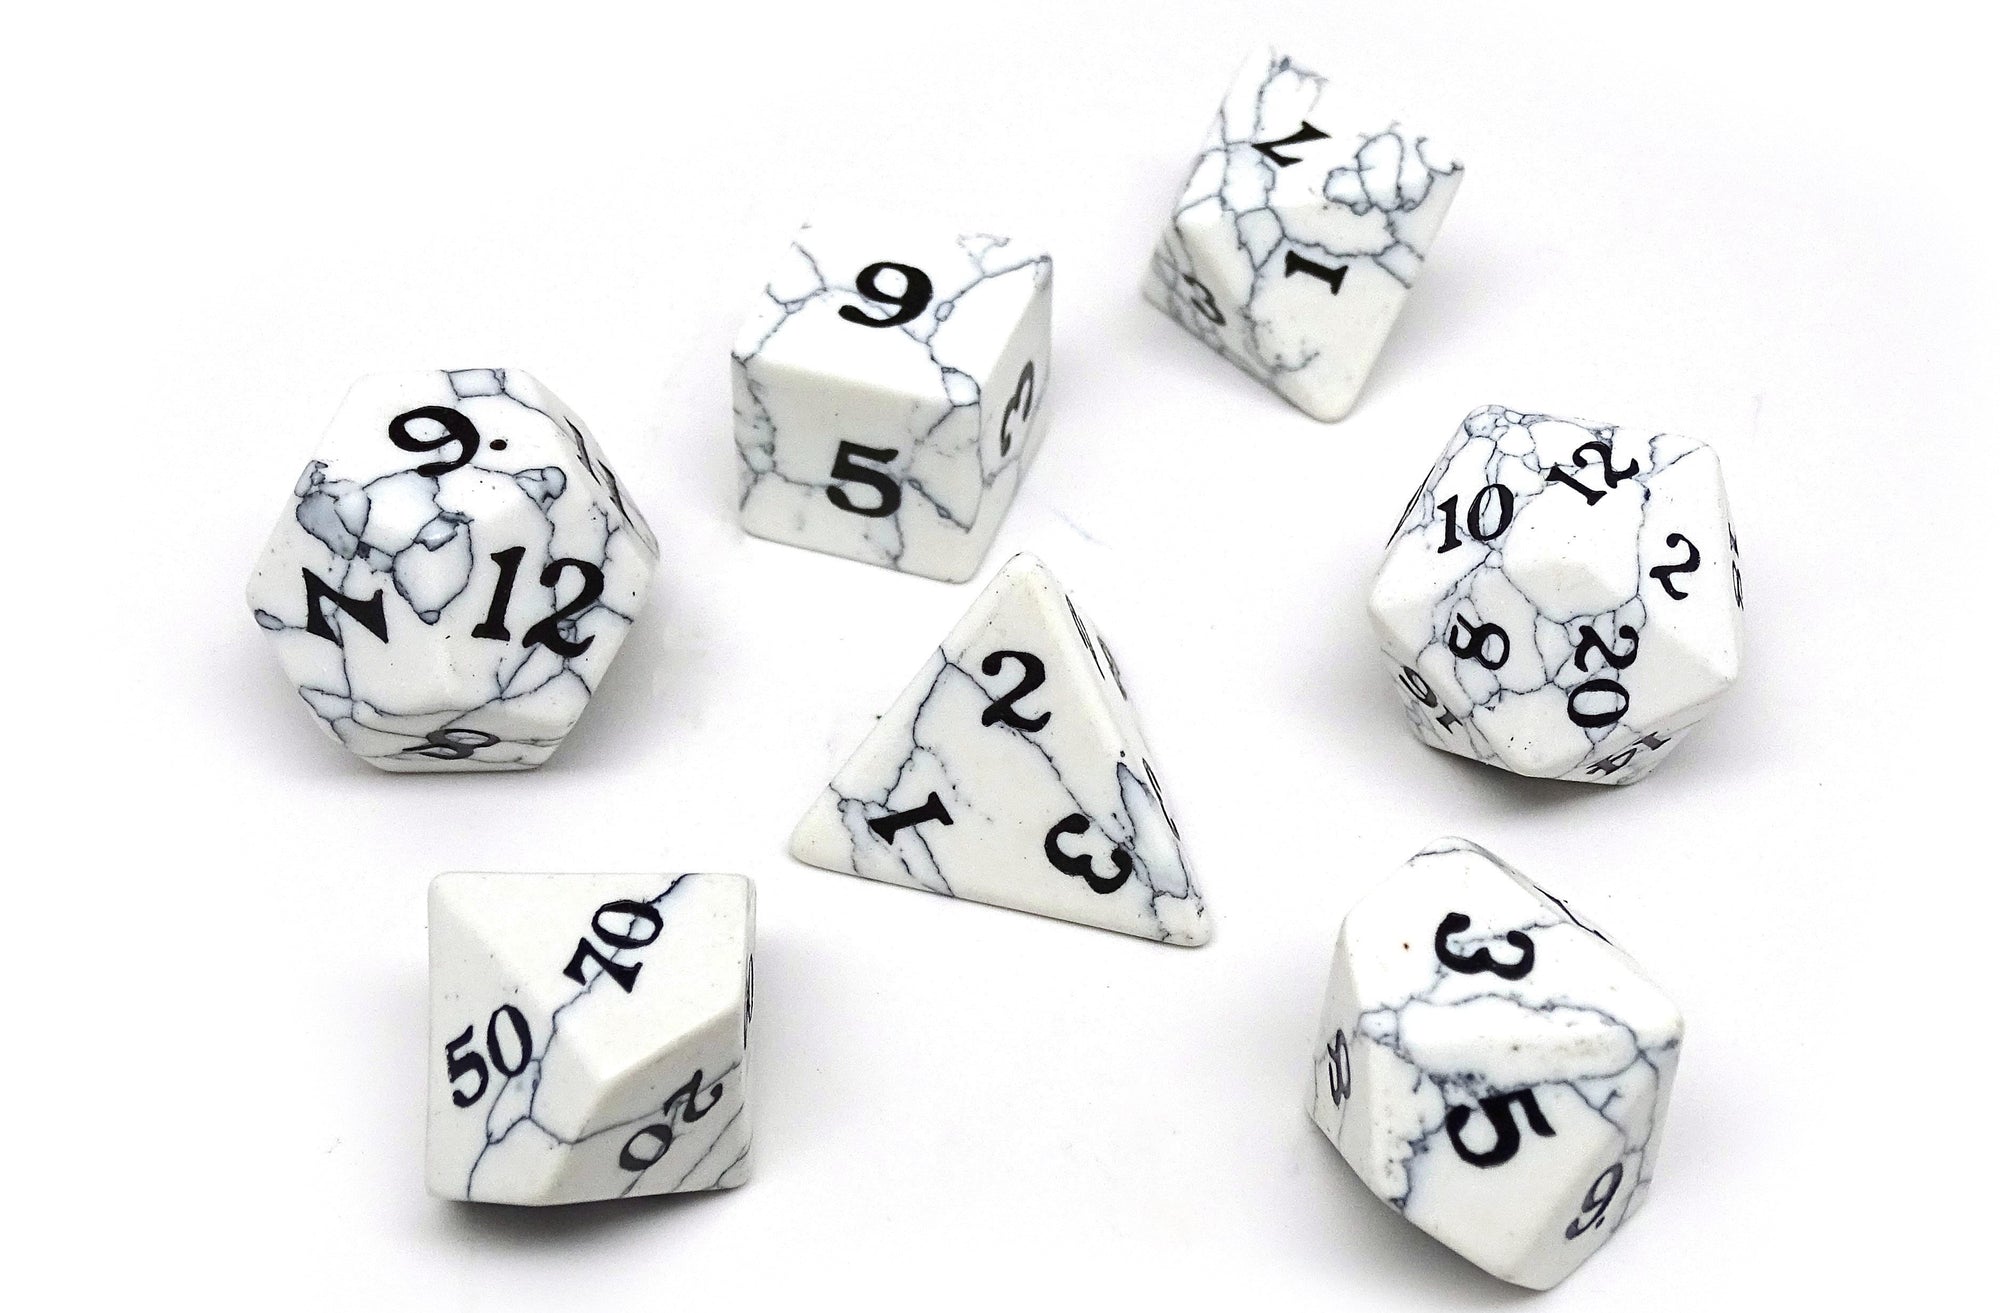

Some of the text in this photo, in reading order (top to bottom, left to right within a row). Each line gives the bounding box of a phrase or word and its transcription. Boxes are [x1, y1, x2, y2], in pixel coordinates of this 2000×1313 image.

[1250, 120, 1330, 168] 7
[1284, 249, 1349, 296] 1
[1000, 359, 1035, 457] 3
[826, 440, 903, 518] 5
[1544, 440, 1641, 507] 12
[1436, 482, 1516, 554] 10
[470, 545, 605, 658] 12
[1649, 532, 1702, 601] 2
[1447, 611, 1511, 671] 8
[1566, 623, 1640, 729] 20
[979, 649, 1053, 734] 2
[866, 790, 955, 847] 1
[1043, 811, 1134, 895] 3
[562, 898, 665, 994] 70
[1433, 911, 1536, 982] 3
[444, 1003, 534, 1109] 50
[618, 1068, 725, 1173] 20
[1444, 1087, 1557, 1169] 5
